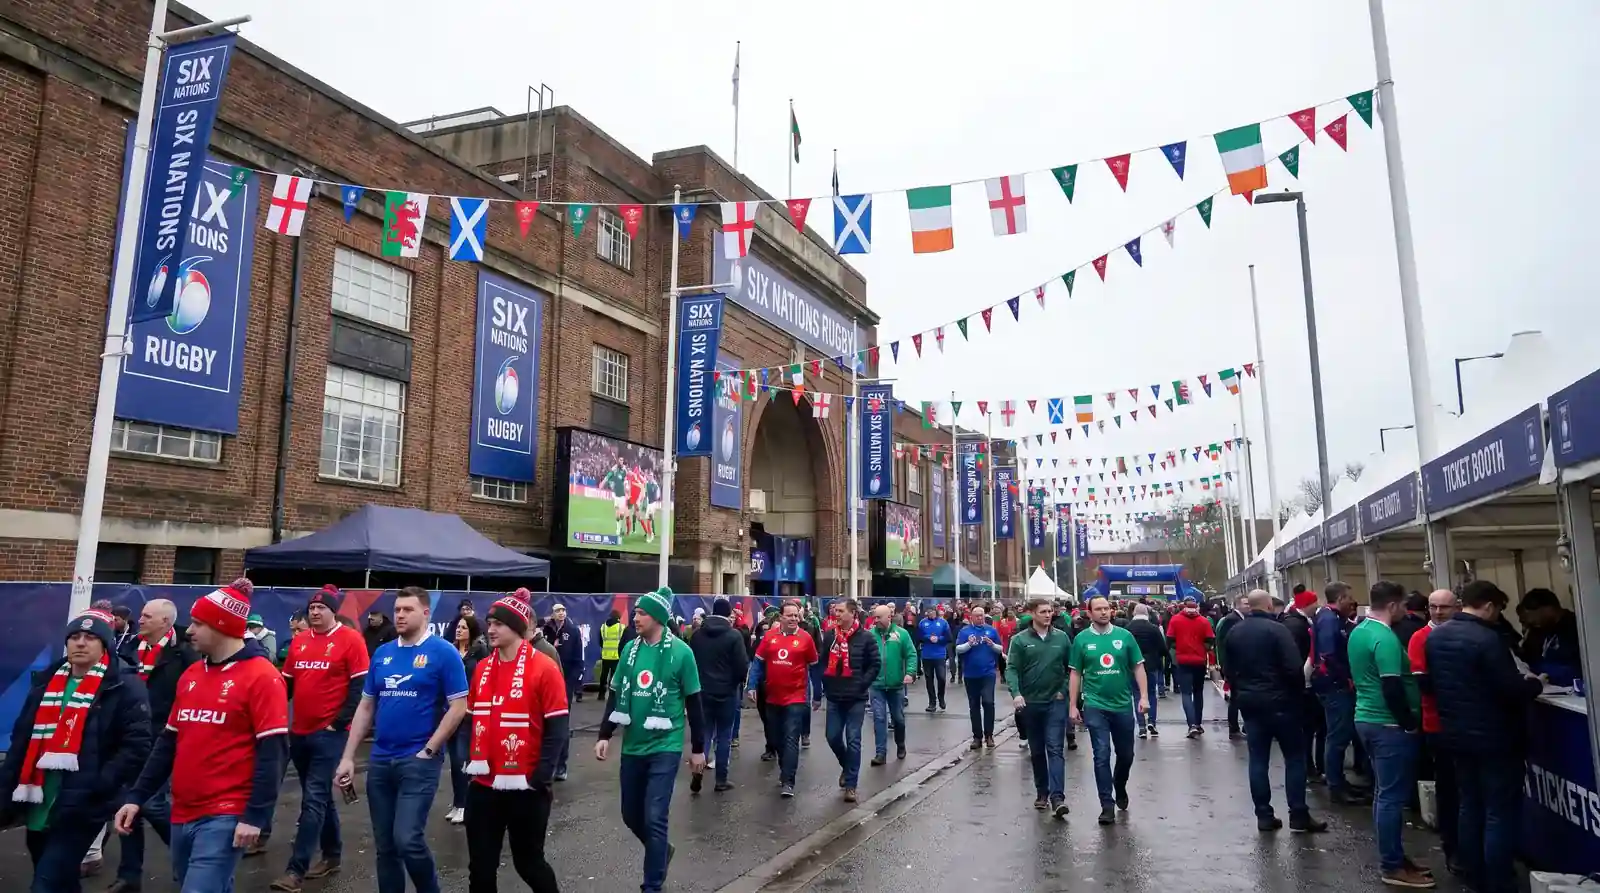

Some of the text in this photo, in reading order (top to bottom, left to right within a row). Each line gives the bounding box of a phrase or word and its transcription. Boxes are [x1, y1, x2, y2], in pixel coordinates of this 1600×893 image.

[176, 55, 214, 85] SIX
[173, 81, 210, 99] NATIONS
[156, 109, 198, 251] SIX NATIONS
[191, 180, 232, 230] IX
[189, 221, 229, 254] IONS
[492, 296, 528, 337] SIX
[688, 318, 713, 327] NATIONS
[689, 304, 714, 319] SIX
[747, 266, 854, 356] SIX NATIONS RUGBY
[144, 336, 218, 375] RUGBY
[491, 327, 528, 354] NATIONS
[688, 333, 707, 417] SIX NATIONS
[487, 417, 524, 443] RUGBY
[870, 414, 882, 431] SIX
[717, 463, 736, 481] RUGBY
[1442, 439, 1506, 493] TICKET BOOTH
[294, 661, 330, 669] ISUZU
[177, 708, 227, 724] ISUZU
[1531, 763, 1600, 838] TICKETS
